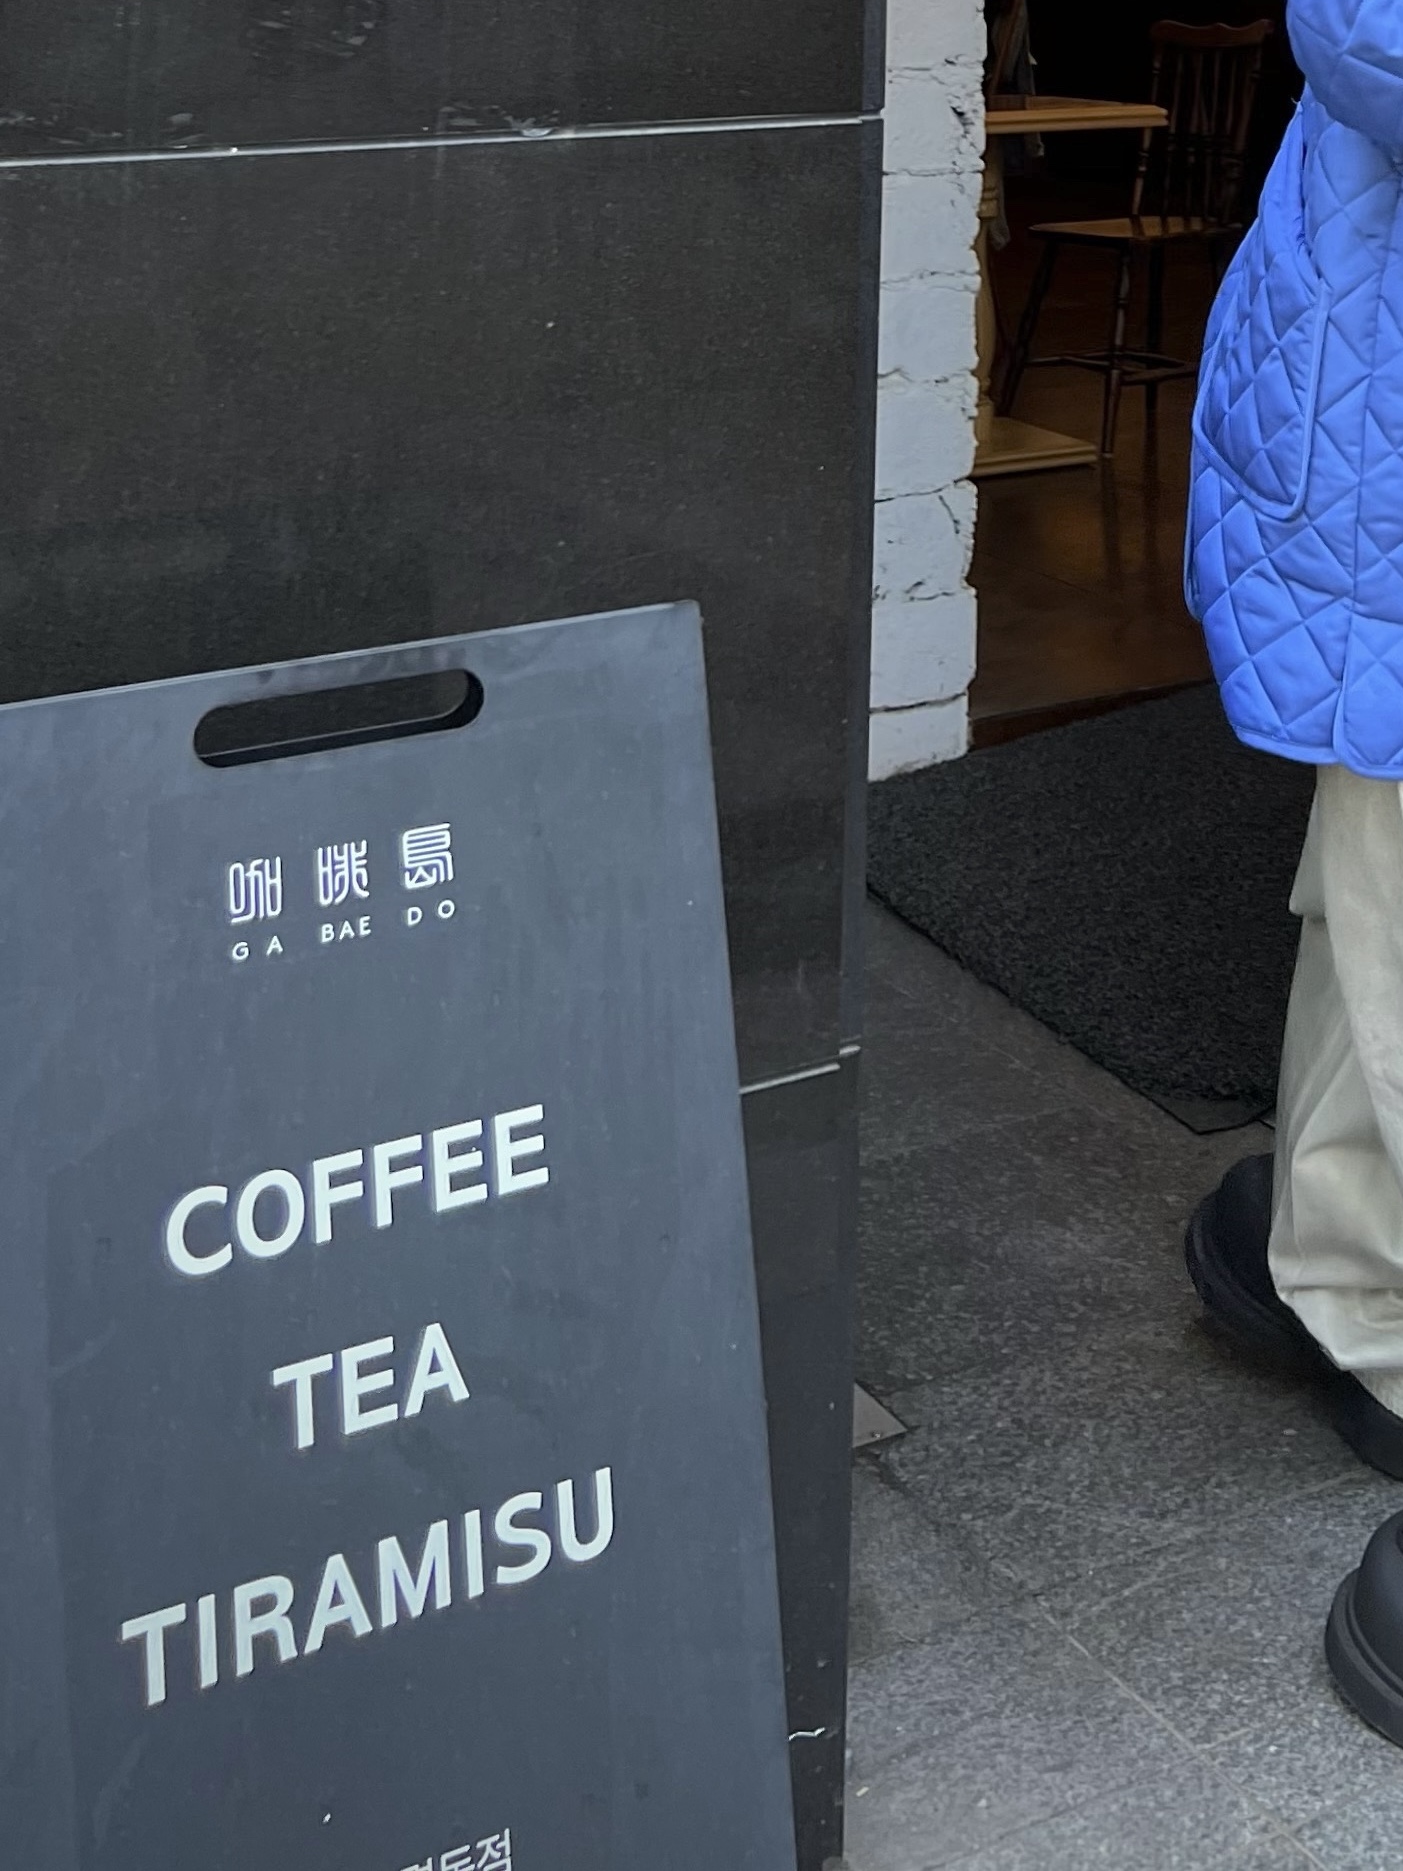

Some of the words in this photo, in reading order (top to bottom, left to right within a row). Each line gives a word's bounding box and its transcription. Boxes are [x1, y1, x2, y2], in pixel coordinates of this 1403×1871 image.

[321, 915, 372, 943] BAE
[166, 1103, 549, 1276] COFFEE
[272, 1322, 470, 1450] TEA
[121, 1466, 614, 1706] TIRAMISU
